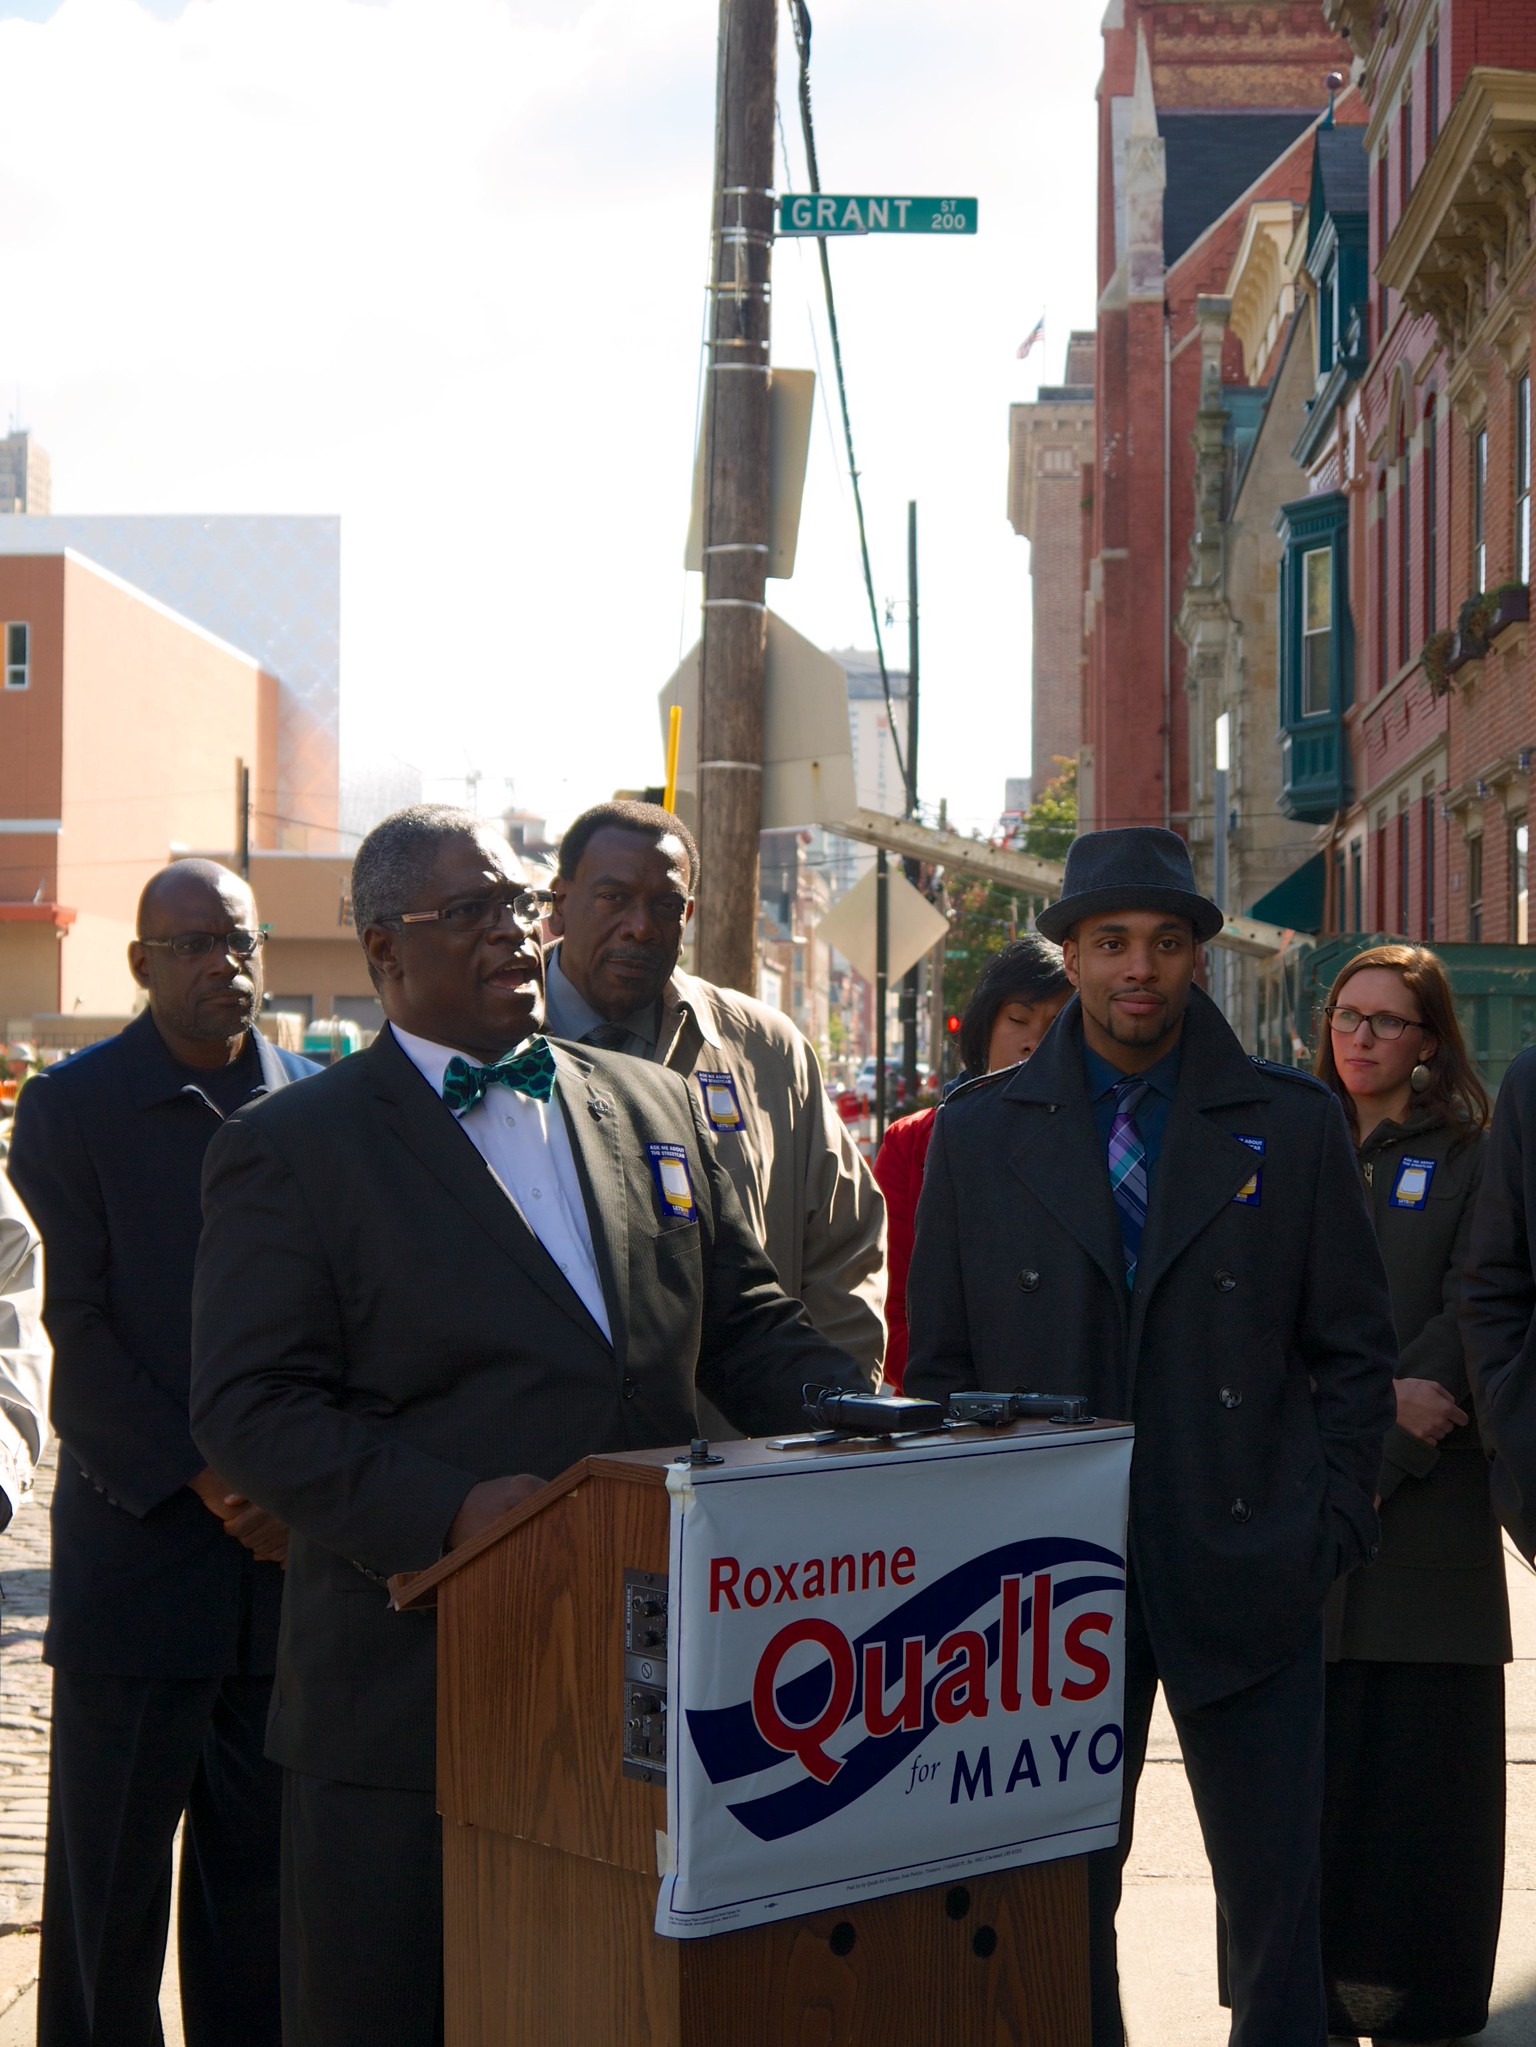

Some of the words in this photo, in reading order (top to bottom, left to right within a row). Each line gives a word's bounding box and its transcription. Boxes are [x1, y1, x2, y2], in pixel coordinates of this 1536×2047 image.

[791, 198, 912, 228] GRANT
[940, 200, 957, 212] ST
[931, 213, 966, 229] 200
[709, 1546, 916, 1613] Roxanne
[752, 1572, 1114, 1786] Qualls
[905, 1754, 941, 1795] for
[950, 1723, 1123, 1804] MAYO
